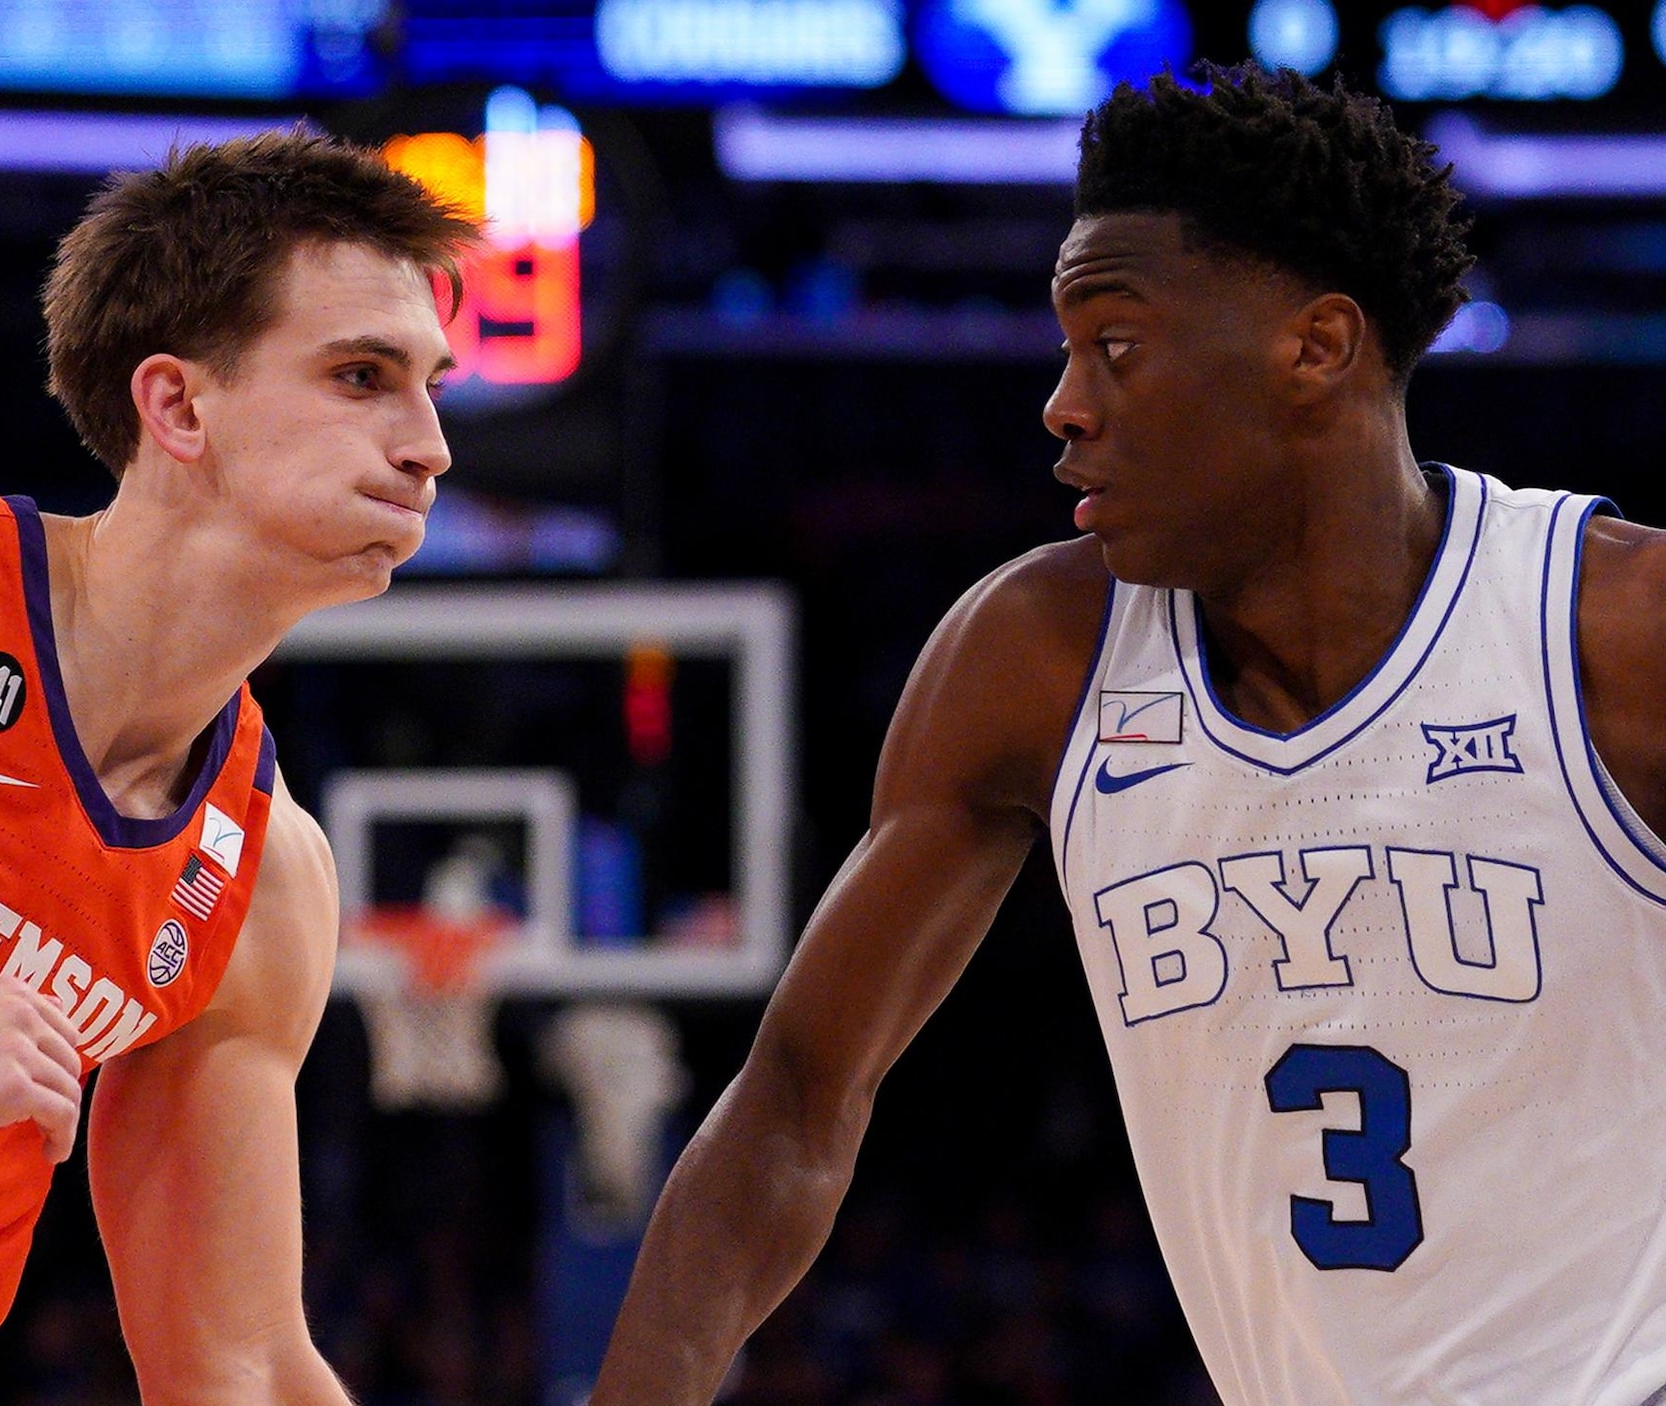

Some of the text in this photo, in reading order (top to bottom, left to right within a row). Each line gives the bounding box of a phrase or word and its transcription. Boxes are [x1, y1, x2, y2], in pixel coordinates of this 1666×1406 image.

[155, 941, 185, 964] ACC
[1093, 844, 1545, 1027] BYU
[1263, 1043, 1424, 1272] 3
